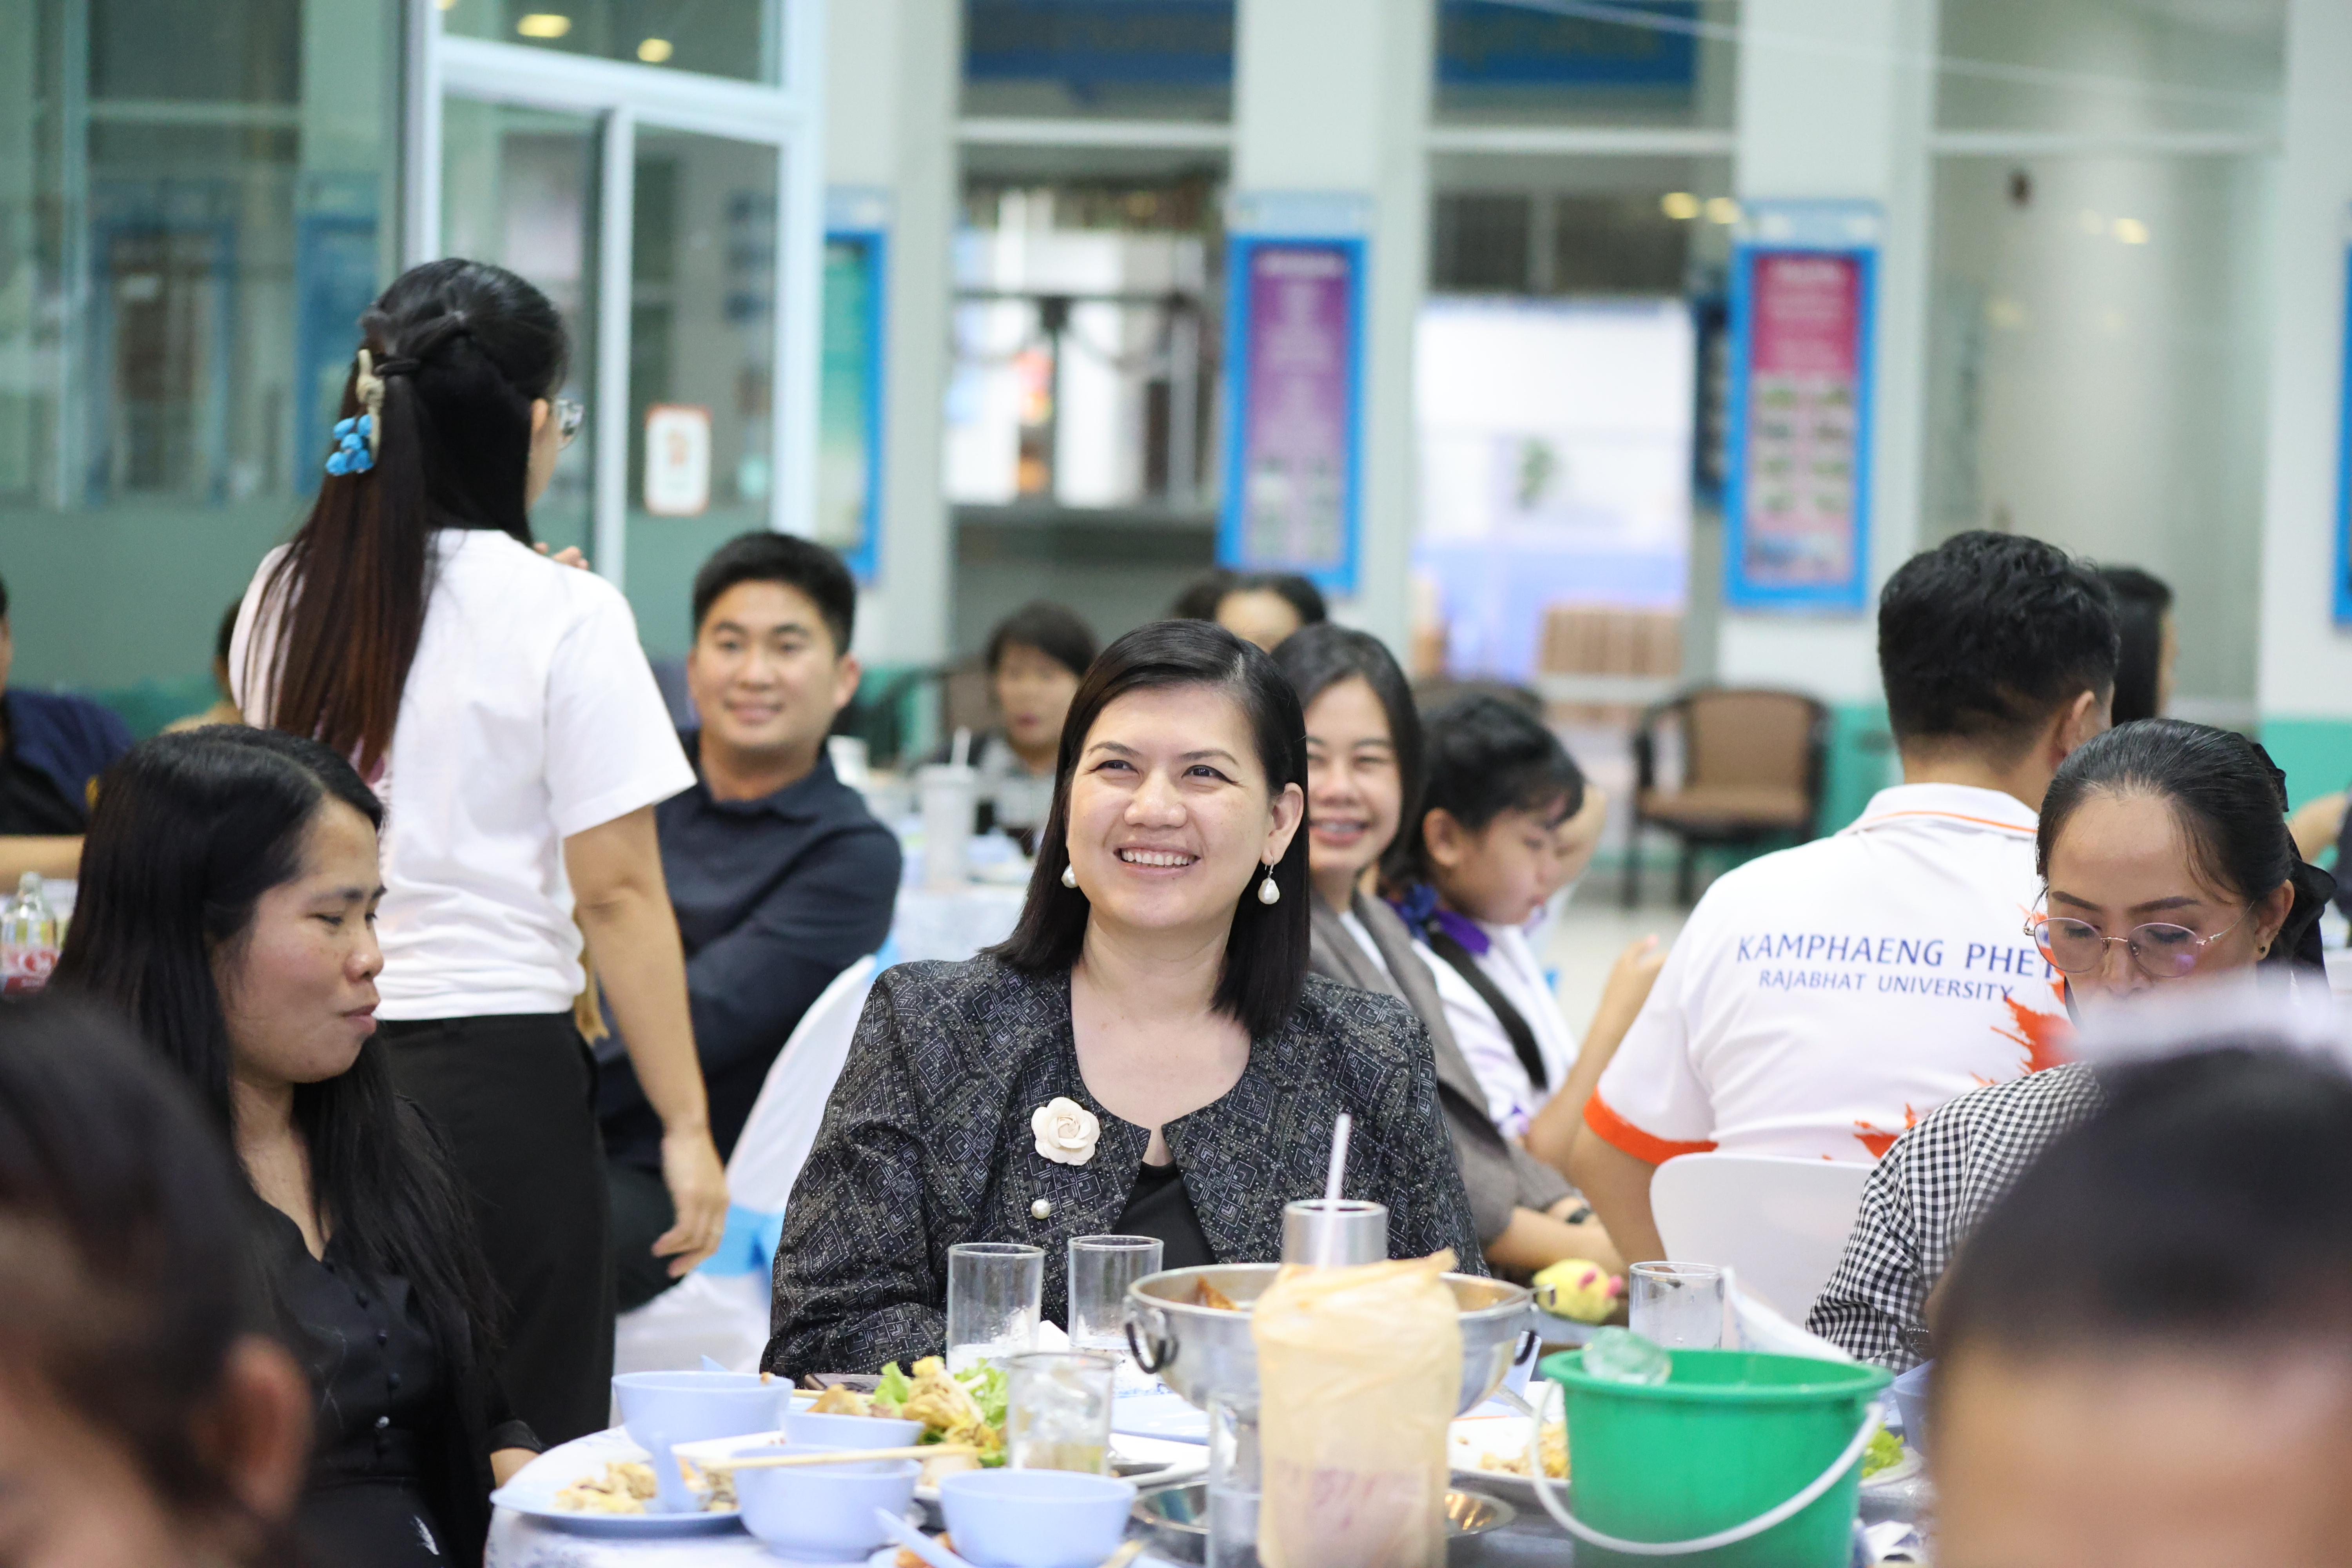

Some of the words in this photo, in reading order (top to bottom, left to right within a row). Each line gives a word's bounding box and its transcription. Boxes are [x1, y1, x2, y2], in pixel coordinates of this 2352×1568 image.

[1737, 933, 1944, 966] KAMPHAENG
[1759, 969, 1866, 991] RAJABHAT
[1878, 975, 2013, 1002] UNIVERSITY
